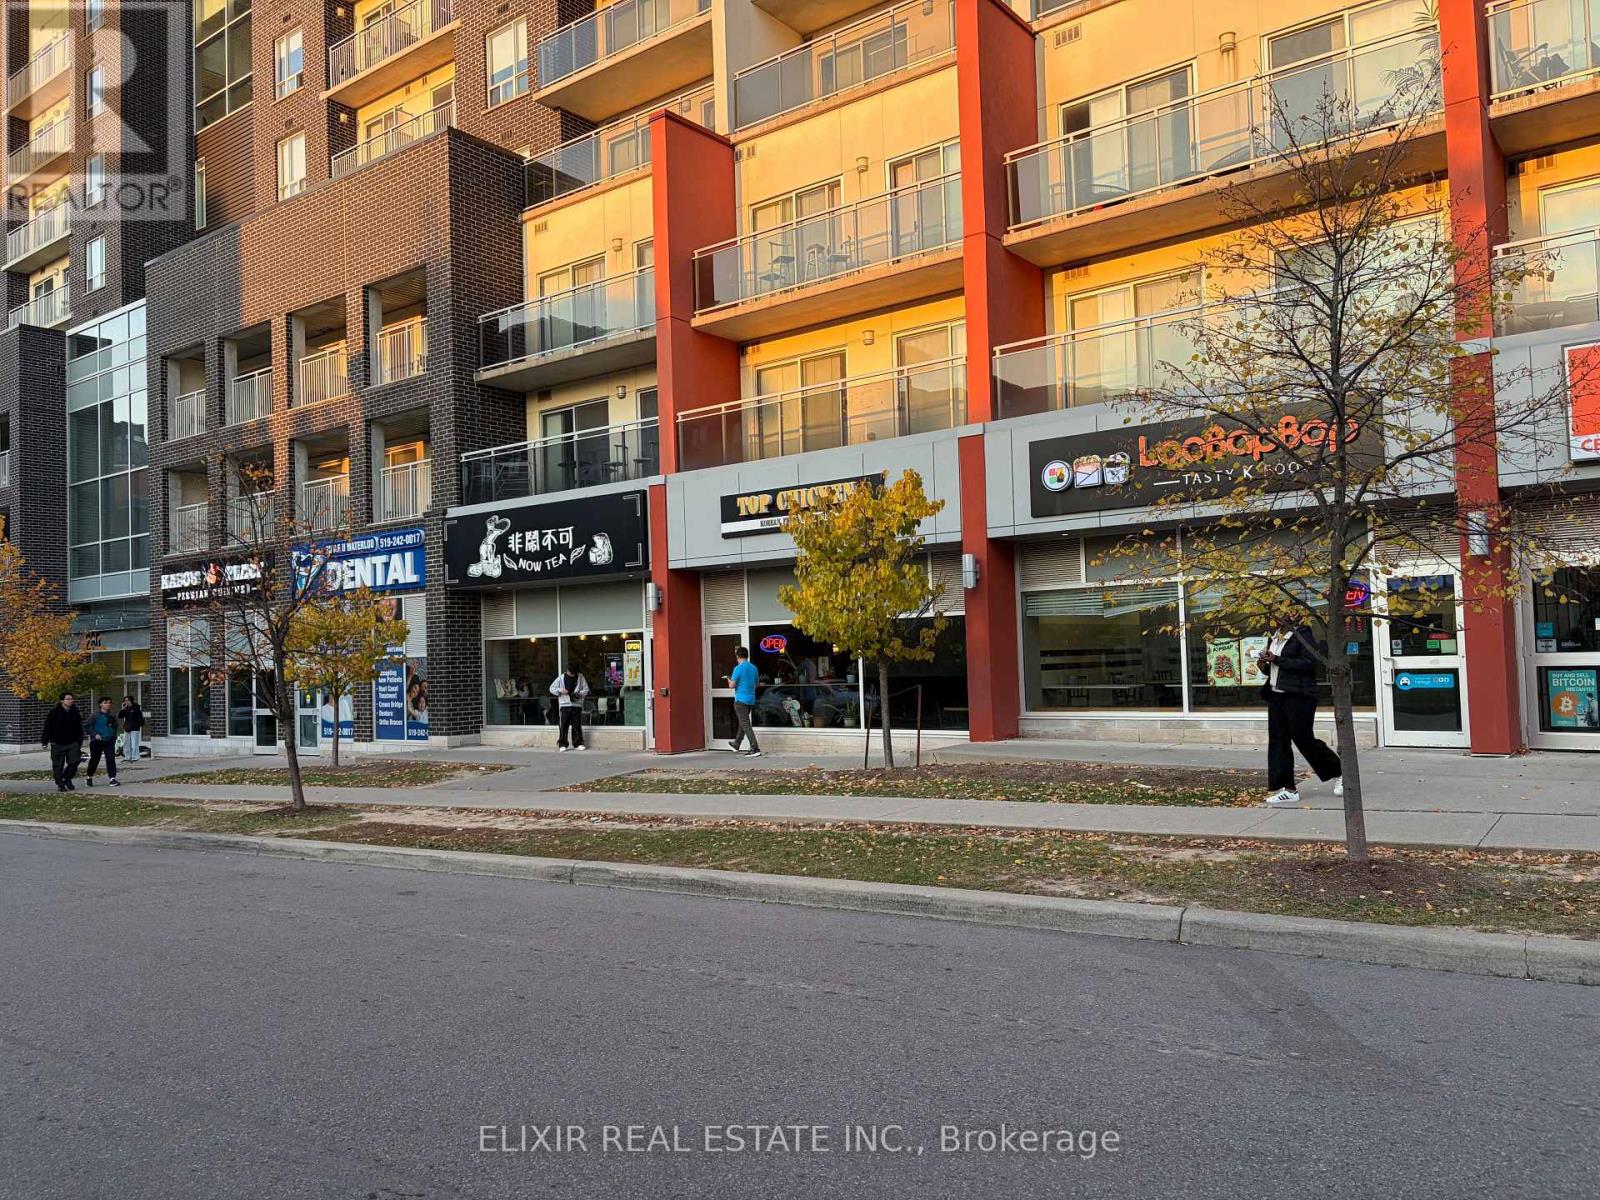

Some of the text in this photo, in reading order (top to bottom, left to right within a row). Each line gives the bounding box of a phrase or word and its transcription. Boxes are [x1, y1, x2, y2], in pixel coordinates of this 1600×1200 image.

[1182, 468, 1234, 486] TASTY
[1243, 465, 1254, 480] K
[736, 494, 770, 516] TOP
[346, 538, 374, 553] WATERLOO
[380, 533, 420, 548] 519-242-0017
[508, 526, 574, 555] 非鬧不可
[518, 553, 567, 572] NOW TEA
[327, 552, 420, 591] DENTAL
[177, 589, 209, 601] PERSIAN
[764, 638, 785, 649] OPEN
[1552, 677, 1595, 687] BITCOIN
[323, 727, 353, 736] 519-2-0017
